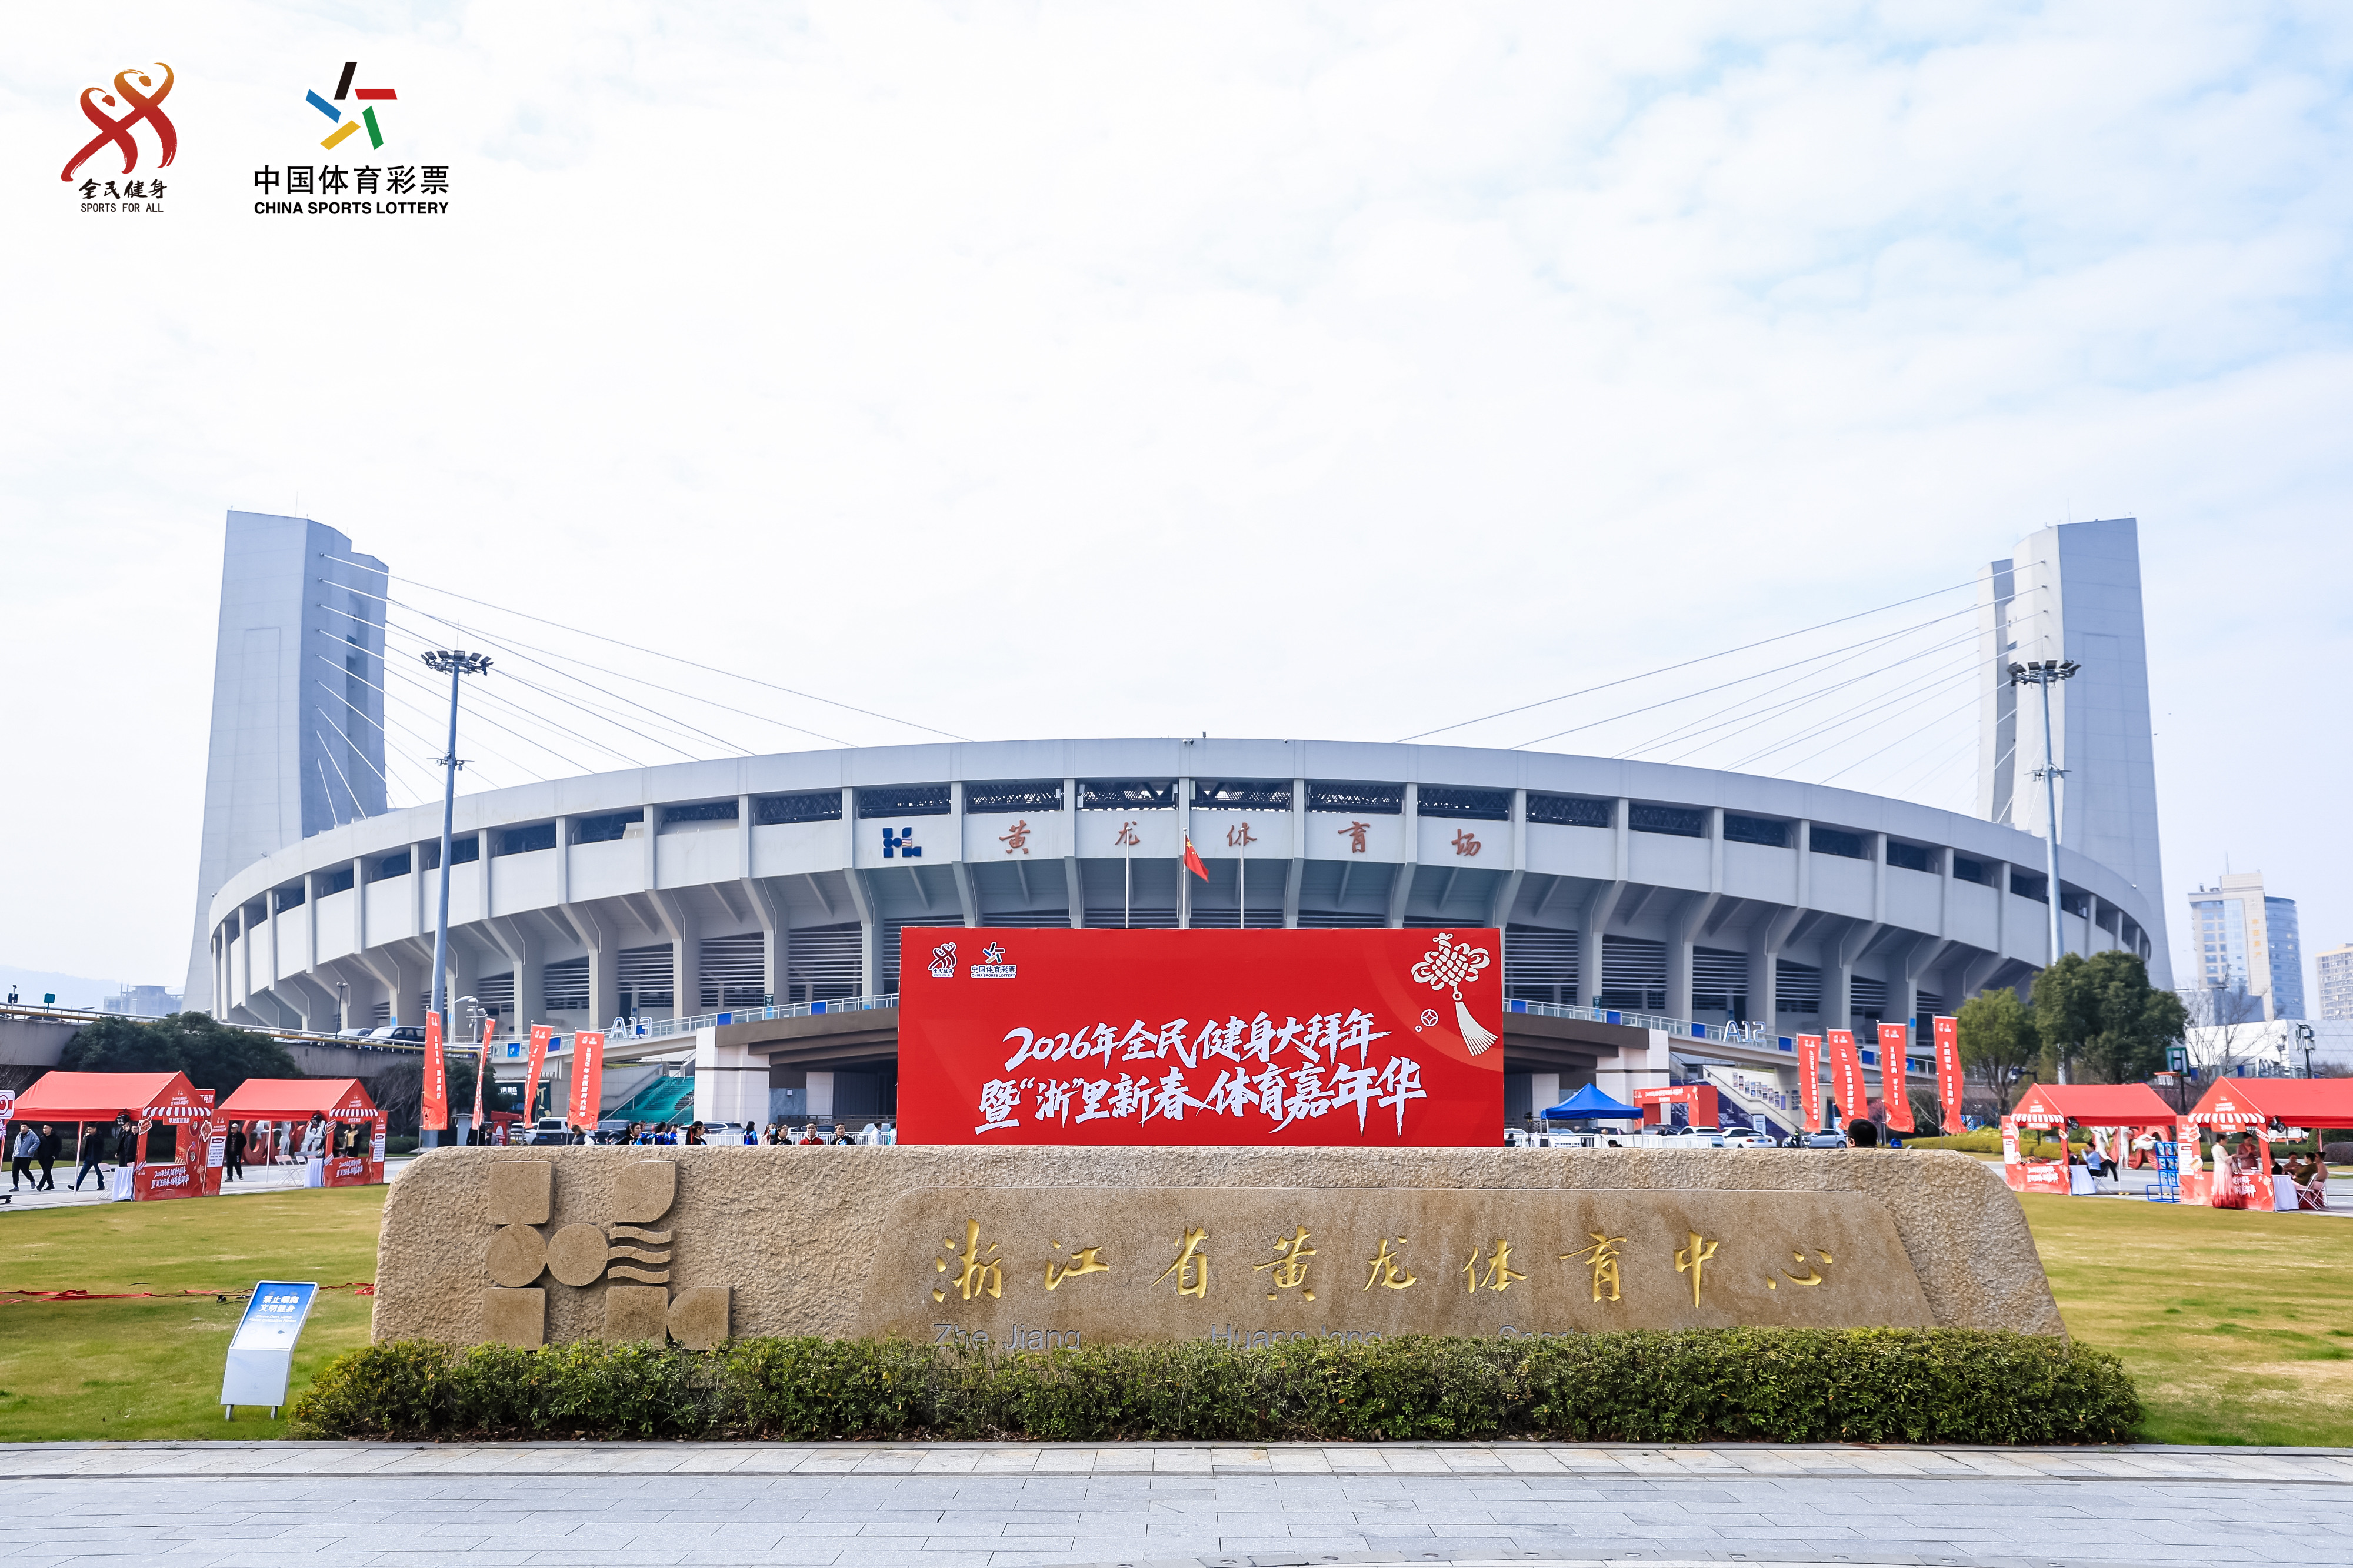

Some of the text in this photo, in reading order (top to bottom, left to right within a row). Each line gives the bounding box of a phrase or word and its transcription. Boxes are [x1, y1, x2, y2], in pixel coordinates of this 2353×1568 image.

[971, 965, 1016, 973] 中国体育彩票
[609, 1016, 653, 1039] A13
[1722, 1020, 1767, 1043] A12
[1003, 1007, 1392, 1072] 2026年全民健身大拜年
[932, 1217, 1834, 1309] 浙江省黄龙体育中心
[259, 1304, 295, 1312] 文明健身
[263, 1296, 299, 1304] 禁止攀爬
